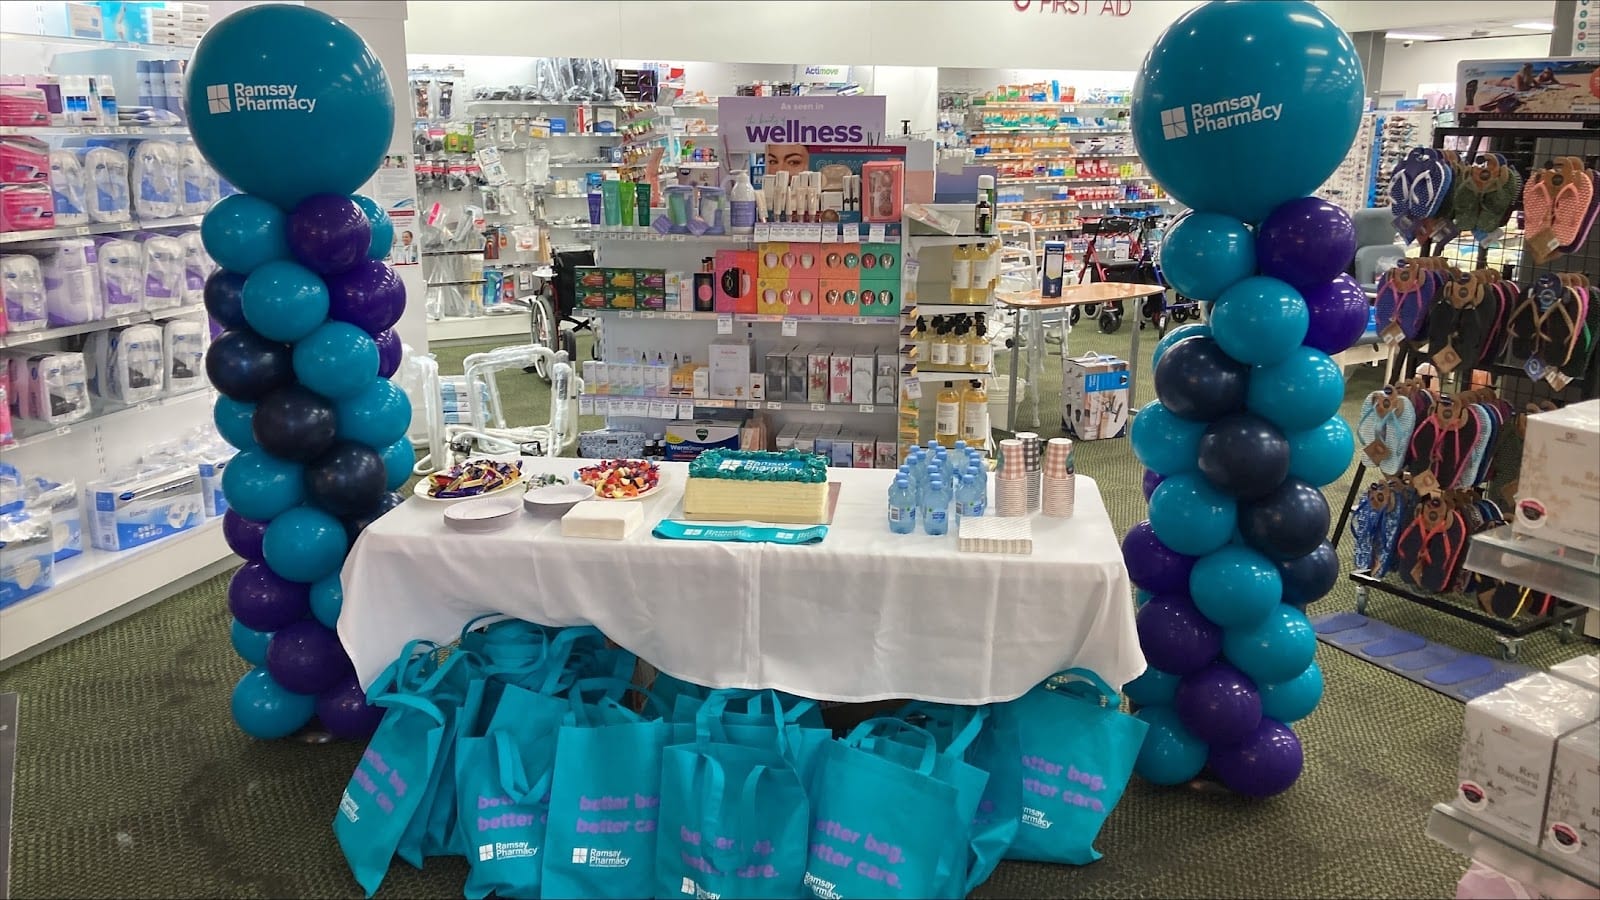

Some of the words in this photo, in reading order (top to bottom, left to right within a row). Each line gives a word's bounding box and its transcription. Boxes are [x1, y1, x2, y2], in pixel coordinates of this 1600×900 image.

[1100, 0, 1132, 16] AID
[805, 66, 839, 75] Actimove
[234, 83, 298, 99] Ramsay
[235, 97, 316, 113] Pharmacy
[780, 103, 791, 111] As
[815, 103, 824, 111] in
[1191, 93, 1261, 119] Ramsay
[1193, 103, 1283, 134] Pharmacy
[745, 120, 863, 143] wellness
[1022, 755, 1063, 776] etter
[1067, 764, 1107, 792] bag.
[579, 795, 630, 812] better
[634, 793, 660, 810] ba
[1023, 778, 1058, 797] tter
[1062, 790, 1106, 814] care.
[1023, 806, 1046, 819] msay
[478, 813, 535, 832] better
[576, 818, 631, 834] better
[634, 819, 657, 834] ca
[1022, 813, 1053, 829] armacy
[681, 825, 735, 850] beer
[496, 842, 529, 853] Ramsay
[496, 847, 538, 859] Pharmacy
[590, 848, 622, 859] Ramsay
[864, 832, 906, 865] bag.
[590, 856, 630, 867] Pharmacy
[857, 861, 903, 890] care.
